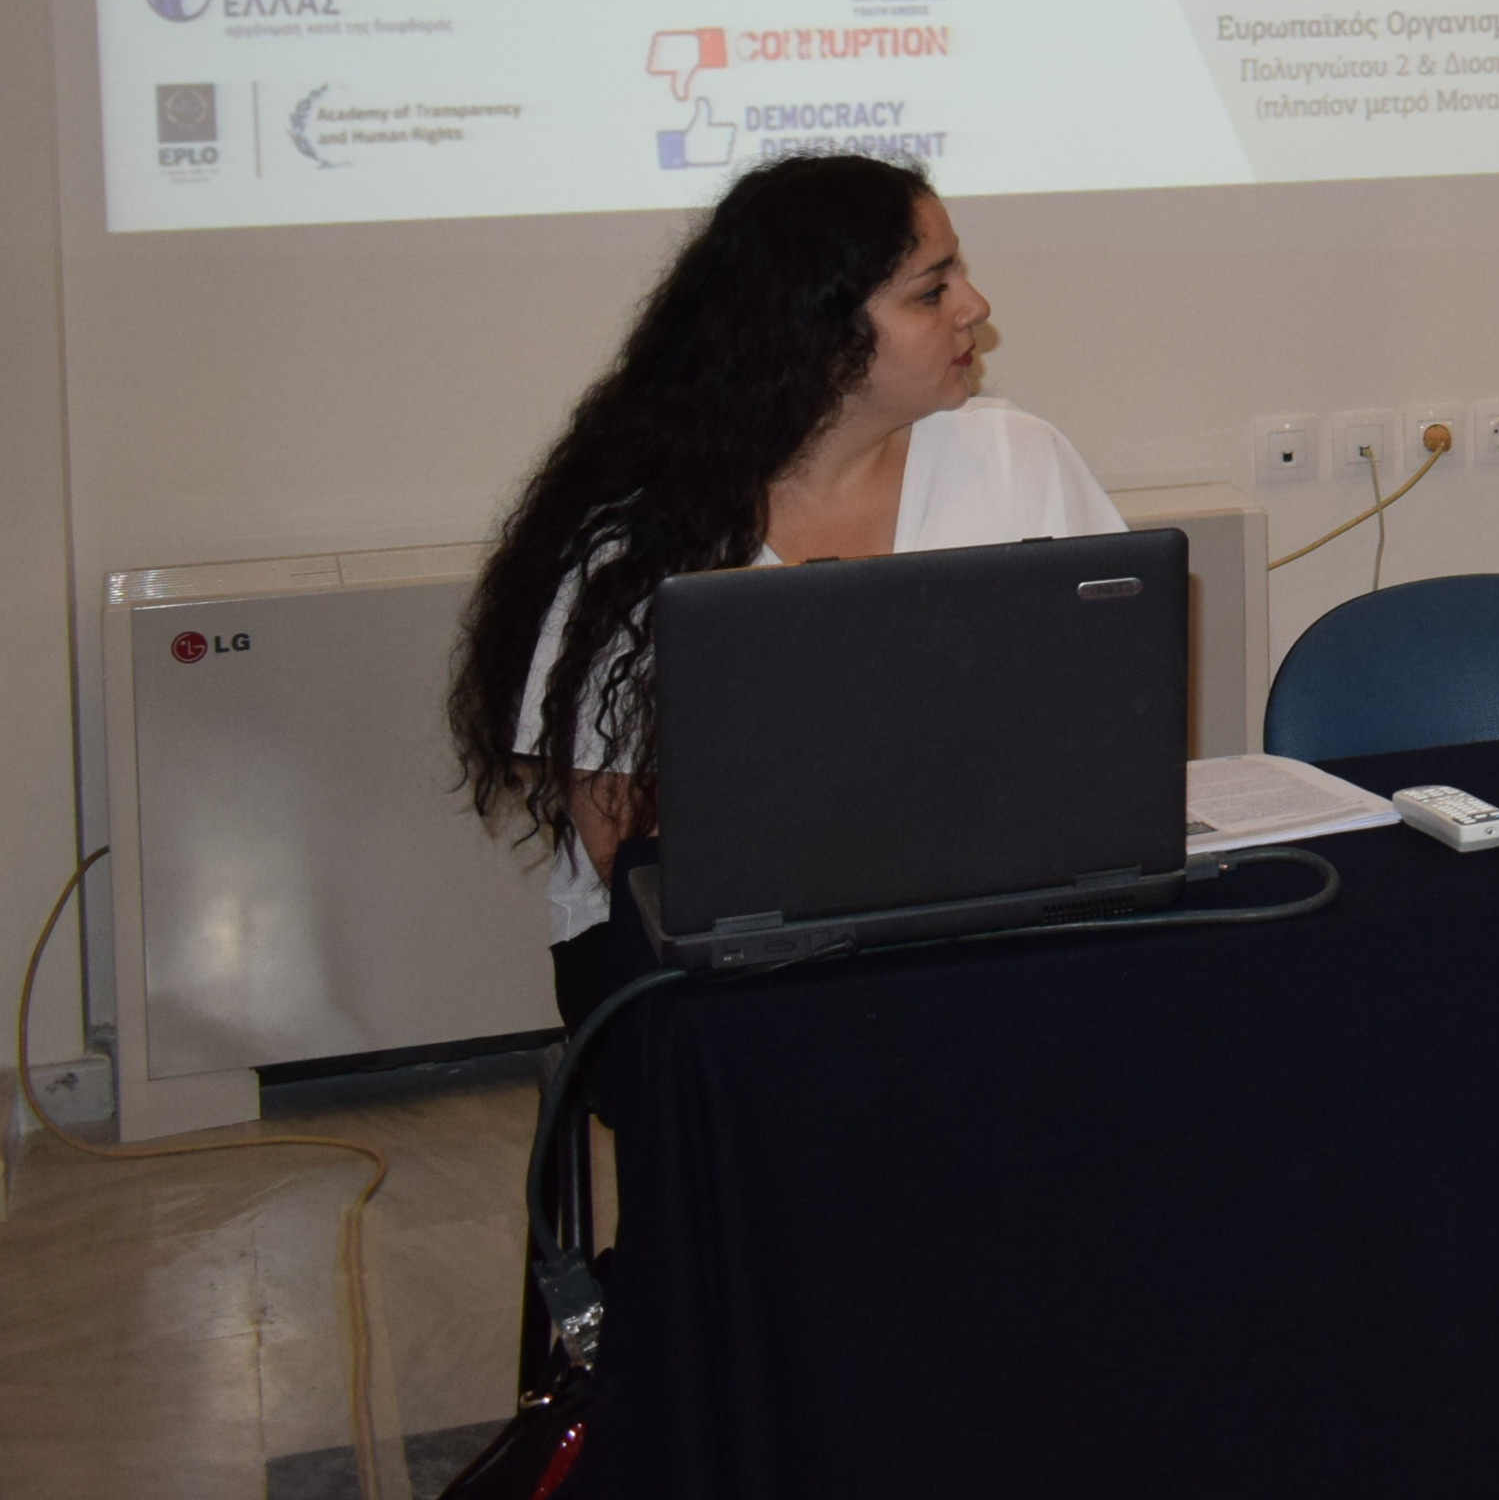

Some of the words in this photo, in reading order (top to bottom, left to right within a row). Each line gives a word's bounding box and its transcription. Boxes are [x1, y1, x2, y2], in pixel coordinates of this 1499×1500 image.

[1216, 10, 1377, 46] Ευρωπαϊκός
[736, 27, 949, 63] CORRUPTION
[1240, 53, 1386, 88] Πολυγνώτου
[1398, 53, 1409, 76] 2
[1417, 54, 1437, 76] &
[317, 104, 389, 122] Academy
[745, 101, 904, 132] DEMOCRACY
[1257, 92, 1357, 124] (πλησίον
[1365, 90, 1428, 122] μετρό
[159, 146, 219, 167] EPLO
[214, 633, 251, 654] LG
